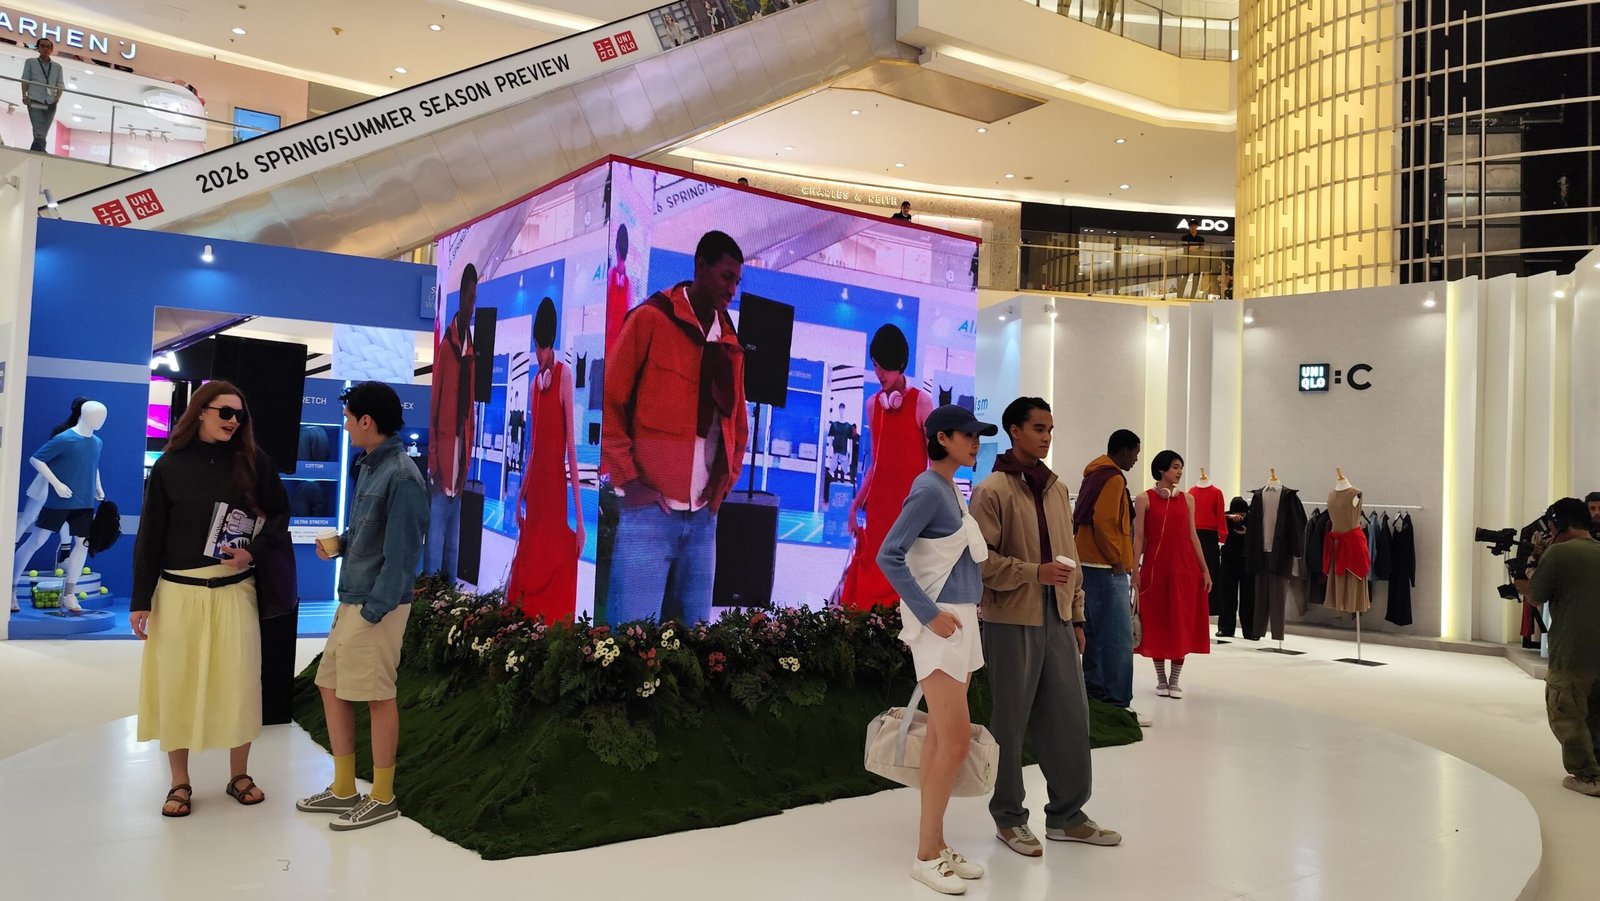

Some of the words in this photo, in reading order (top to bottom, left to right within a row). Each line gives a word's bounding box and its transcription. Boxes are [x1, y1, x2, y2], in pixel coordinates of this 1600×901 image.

[195, 162, 249, 193] 2026
[254, 106, 416, 173] SPRING/SUMMER
[419, 80, 492, 118] SEASON
[494, 53, 570, 92] PREVIEW
[801, 186, 849, 200] CHARLES
[854, 192, 862, 202] &
[868, 194, 898, 206] KEITH
